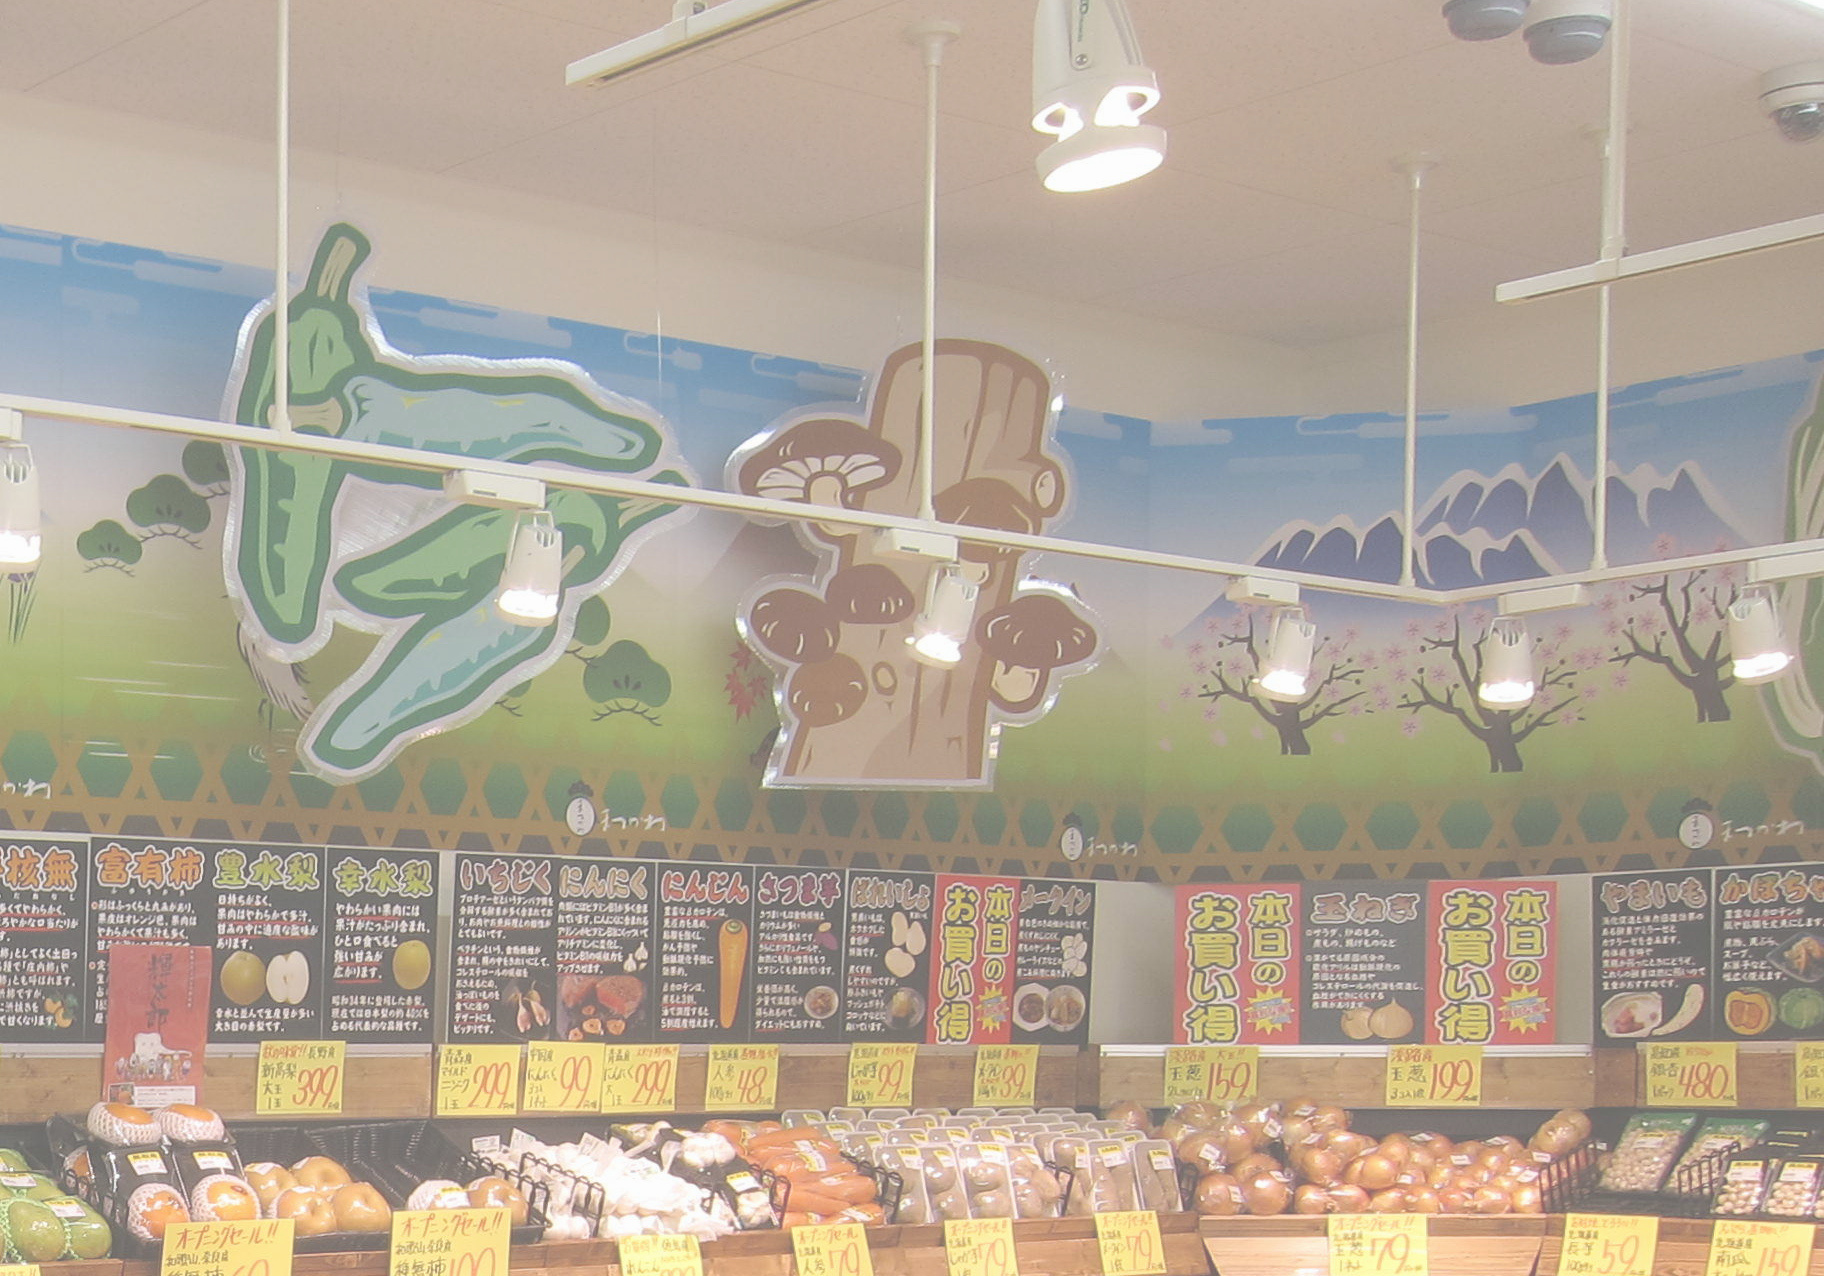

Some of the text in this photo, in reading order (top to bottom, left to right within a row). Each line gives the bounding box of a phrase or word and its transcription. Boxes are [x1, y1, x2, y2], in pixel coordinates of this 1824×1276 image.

[96, 843, 205, 889] 富有柿
[213, 849, 319, 892] 豊水梨
[333, 857, 433, 898] 幸水梨
[460, 858, 552, 895] いちじく
[559, 865, 648, 899] にんにく
[218, 894, 271, 906] 日持ちがよく、
[661, 870, 749, 904] にんじん
[758, 872, 841, 908] さつま芋
[850, 877, 931, 911] ばれいしょ
[1019, 884, 1092, 916] メークイン
[1601, 876, 1707, 913] やまいも
[336, 903, 420, 917] やわらかい果肉には
[1311, 892, 1419, 924] 玉ねぎ
[217, 940, 254, 950] あります。
[334, 935, 398, 948] ひと口食べると
[982, 883, 1015, 982] 本日の
[1245, 890, 1292, 985] 本日の
[1500, 889, 1548, 984] 本日の
[333, 966, 382, 980] 広がります。
[933, 882, 981, 1044] お買い得
[1183, 891, 1242, 1044] お買い得
[1436, 889, 1497, 1045] お買い得
[307, 1046, 336, 1058] 長野産
[292, 1065, 338, 1108] 399
[468, 1062, 511, 1108] 299
[560, 1056, 592, 1108] 99
[631, 1059, 671, 1105] 299
[738, 1066, 767, 1103] 48
[1001, 1063, 1025, 1098] 39
[1207, 1062, 1250, 1100] 159
[1429, 1059, 1474, 1100] 199
[1679, 1062, 1729, 1099] 480
[176, 1223, 277, 1249] オープニングセール!!
[402, 1212, 503, 1237] オープニングセール!!
[1126, 1229, 1151, 1269] 79
[1371, 1233, 1409, 1274] 79
[1597, 1235, 1640, 1275] 59
